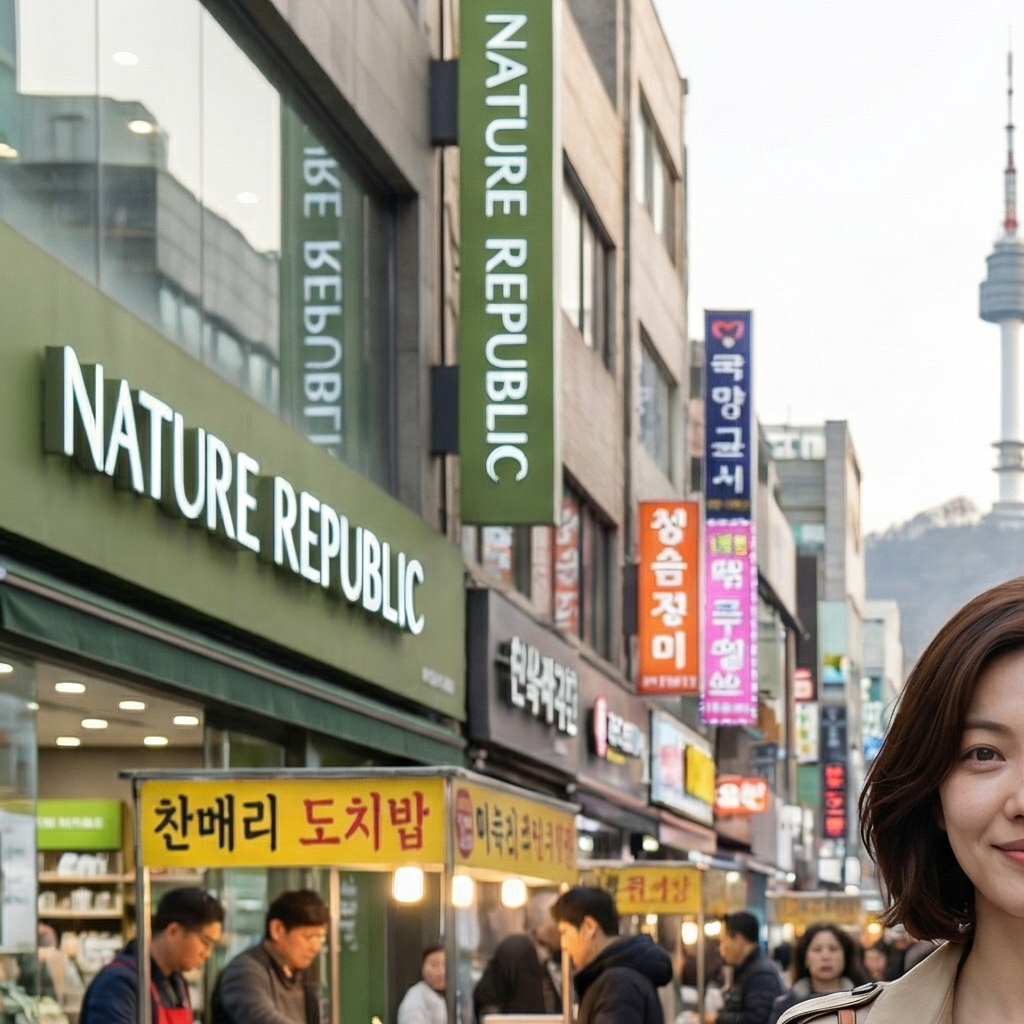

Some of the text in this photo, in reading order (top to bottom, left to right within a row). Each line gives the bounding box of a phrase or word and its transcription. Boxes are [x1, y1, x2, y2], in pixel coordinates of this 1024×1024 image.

[485, 14, 528, 217] NATURE
[485, 238, 528, 482] REPUBLIC
[63, 344, 261, 553] NATURE
[273, 475, 425, 636] REPUBLIC
[299, 791, 430, 853] 도치밥
